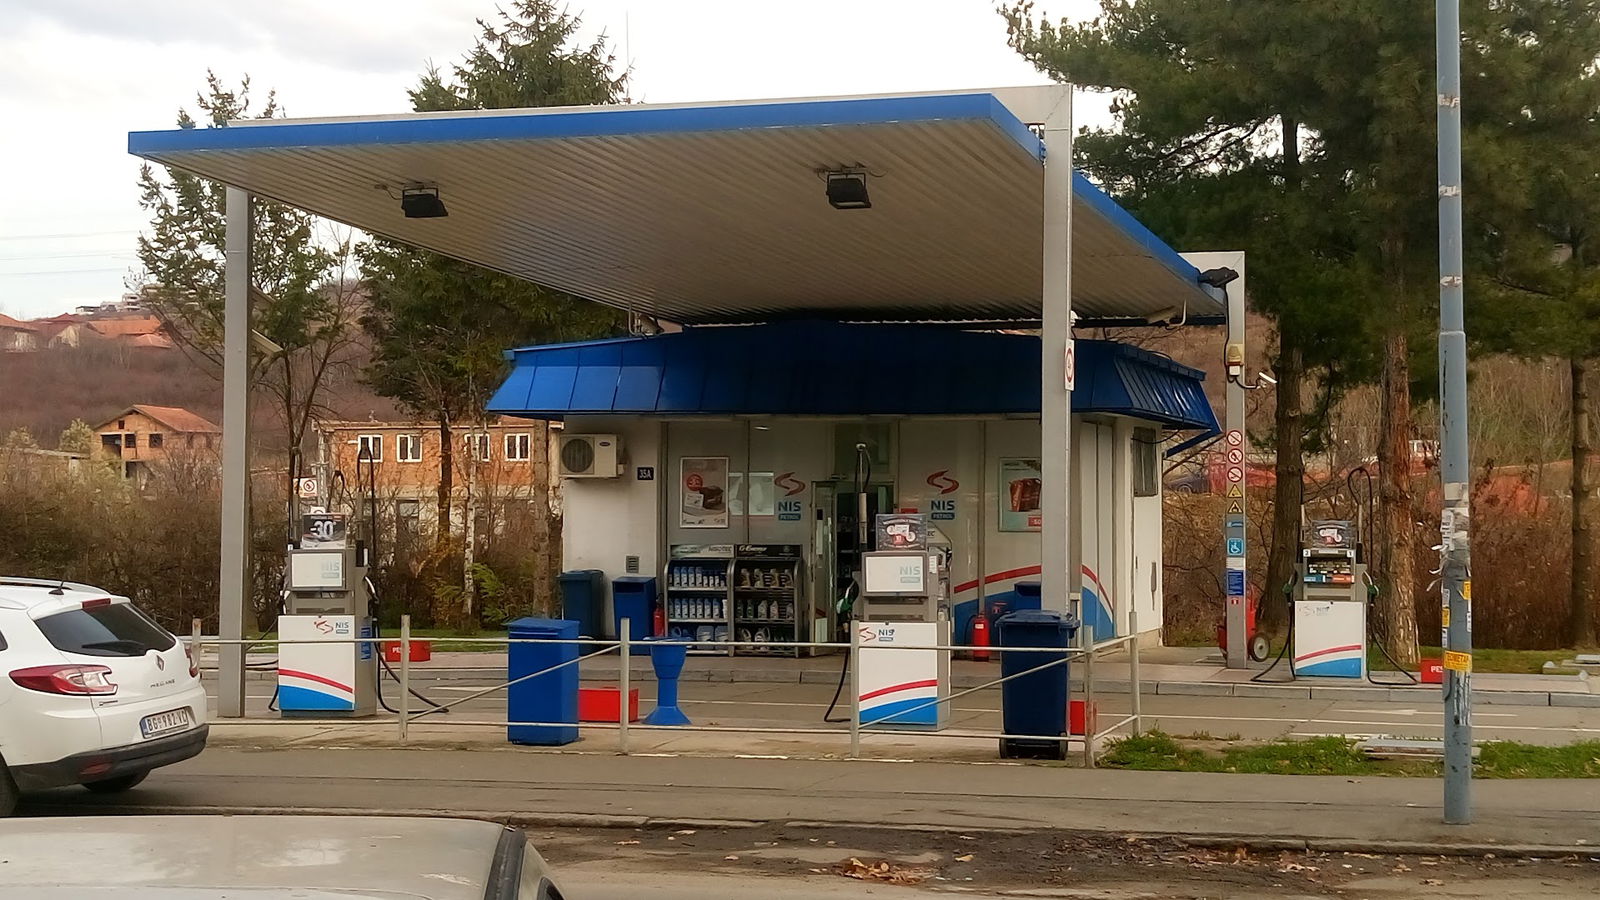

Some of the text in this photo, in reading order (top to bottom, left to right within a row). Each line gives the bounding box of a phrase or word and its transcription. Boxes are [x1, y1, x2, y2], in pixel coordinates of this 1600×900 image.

[778, 501, 801, 511] NIS
[931, 500, 955, 511] NIS
[900, 566, 920, 575] NIS
